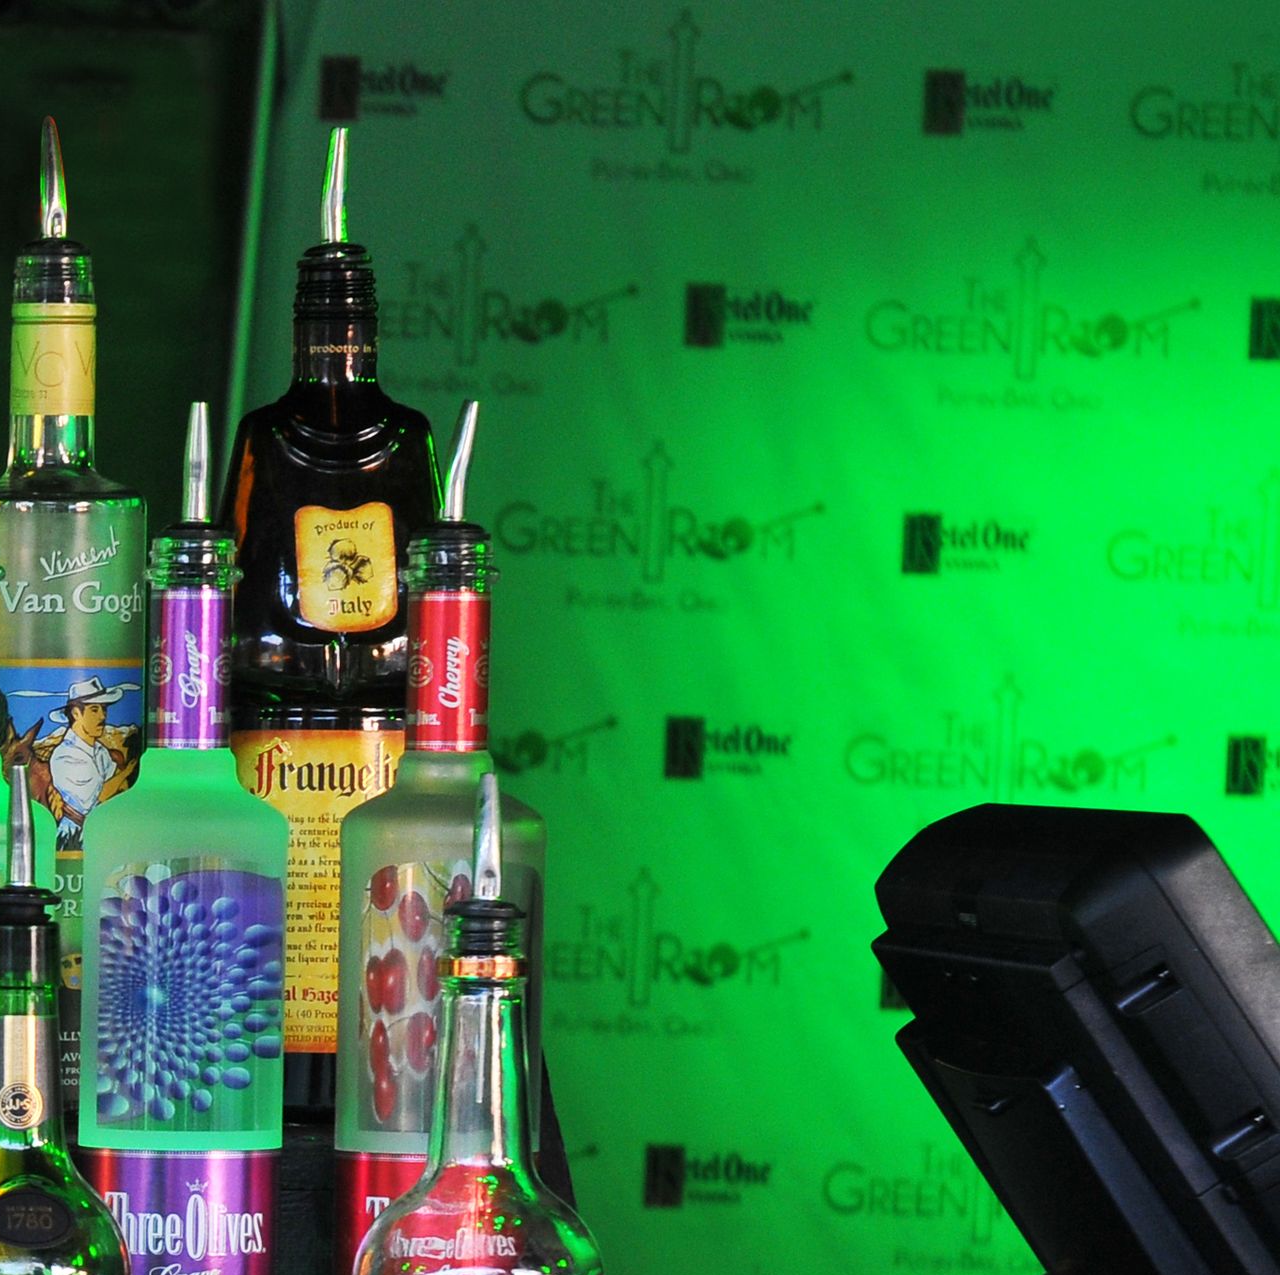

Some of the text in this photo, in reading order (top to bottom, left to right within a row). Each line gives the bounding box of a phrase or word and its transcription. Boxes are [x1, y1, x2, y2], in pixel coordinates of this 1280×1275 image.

[521, 73, 666, 127] GREEN
[867, 300, 1010, 354] GREEN
[40, 525, 120, 577] Vincent
[316, 520, 375, 535] Product of
[494, 503, 640, 557] GREEN
[982, 524, 1030, 552] One
[73, 581, 142, 623] Gogh
[329, 596, 373, 616] Italy
[178, 631, 209, 708] Grape
[438, 636, 470, 709] Cherry
[844, 735, 990, 790] GREEN
[7, 1213, 53, 1228] 1780
[105, 1192, 184, 1256] Three
